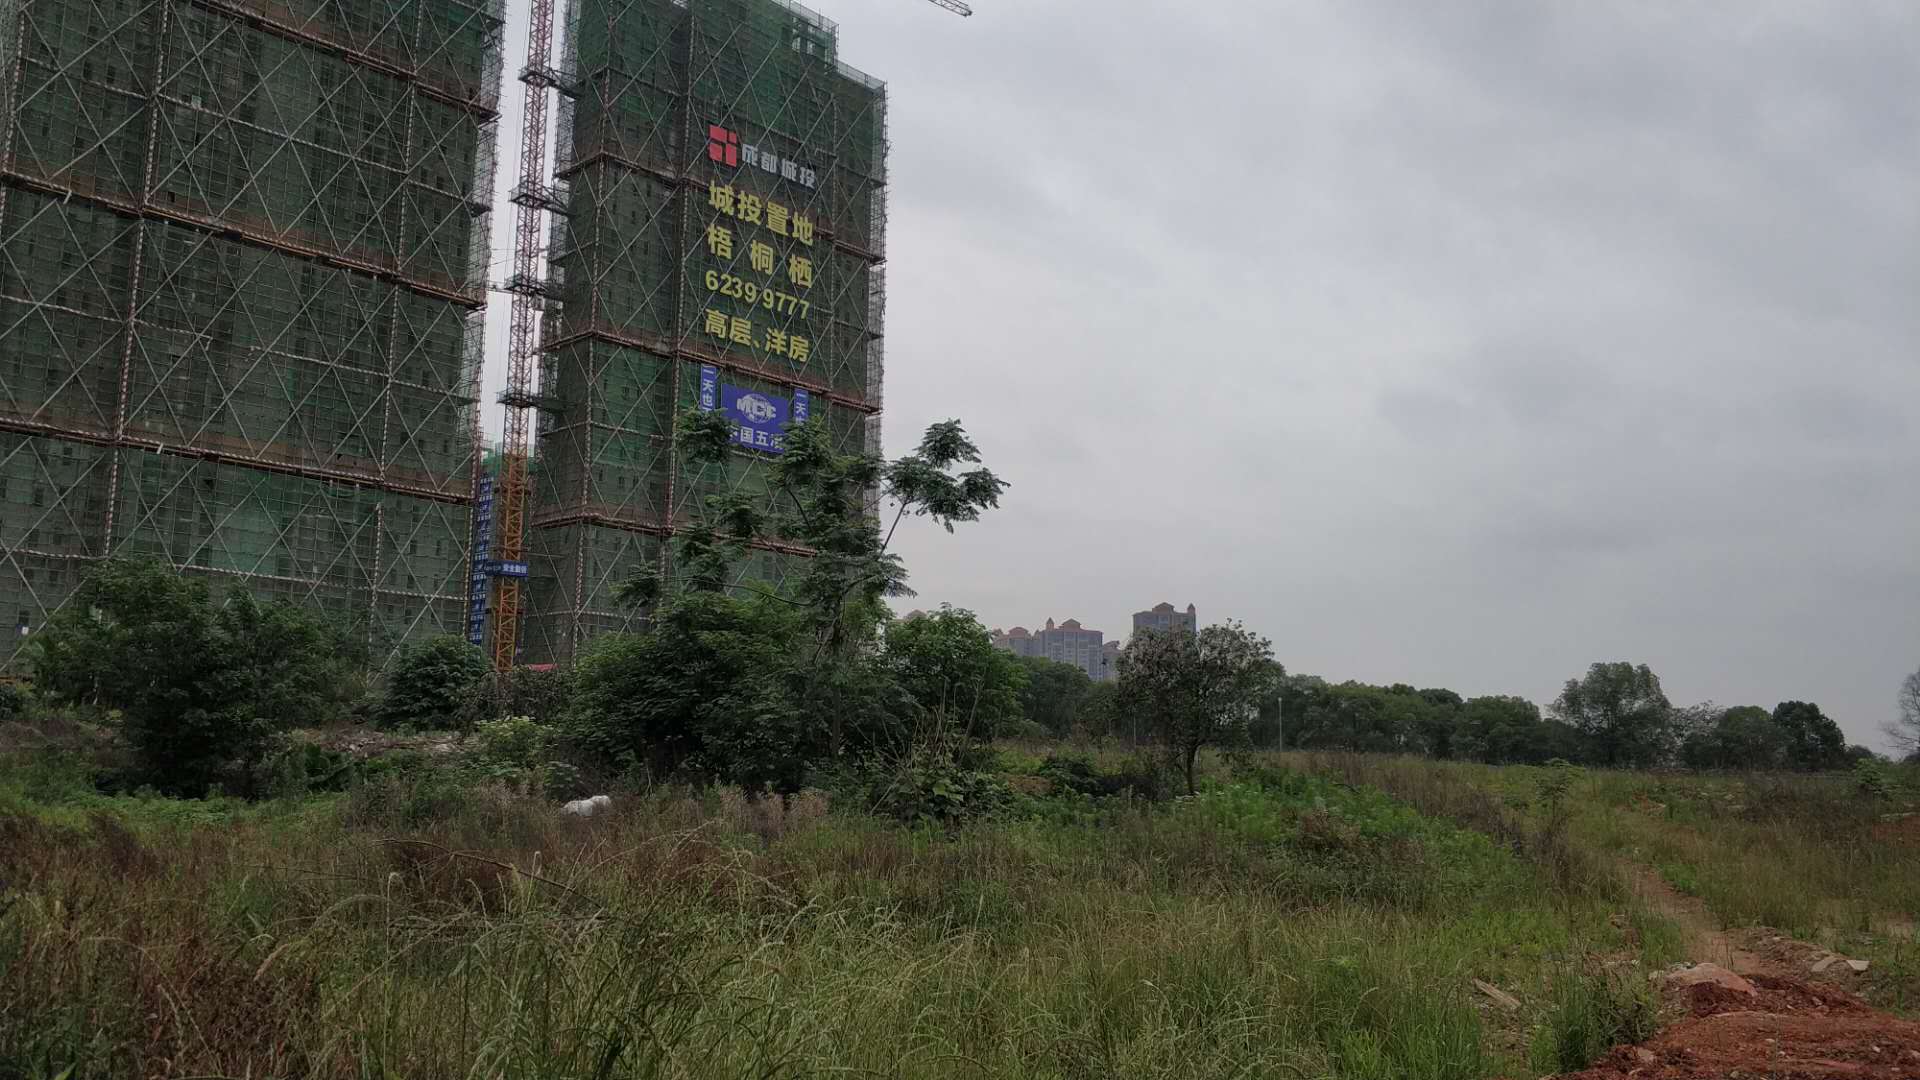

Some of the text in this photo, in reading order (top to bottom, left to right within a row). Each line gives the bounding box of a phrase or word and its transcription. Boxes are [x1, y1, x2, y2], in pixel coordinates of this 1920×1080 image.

[741, 143, 815, 189] 成都城投
[708, 180, 813, 246] 城投置地
[707, 223, 812, 288] 梧桐栖
[705, 308, 809, 362] 高层、洋房
